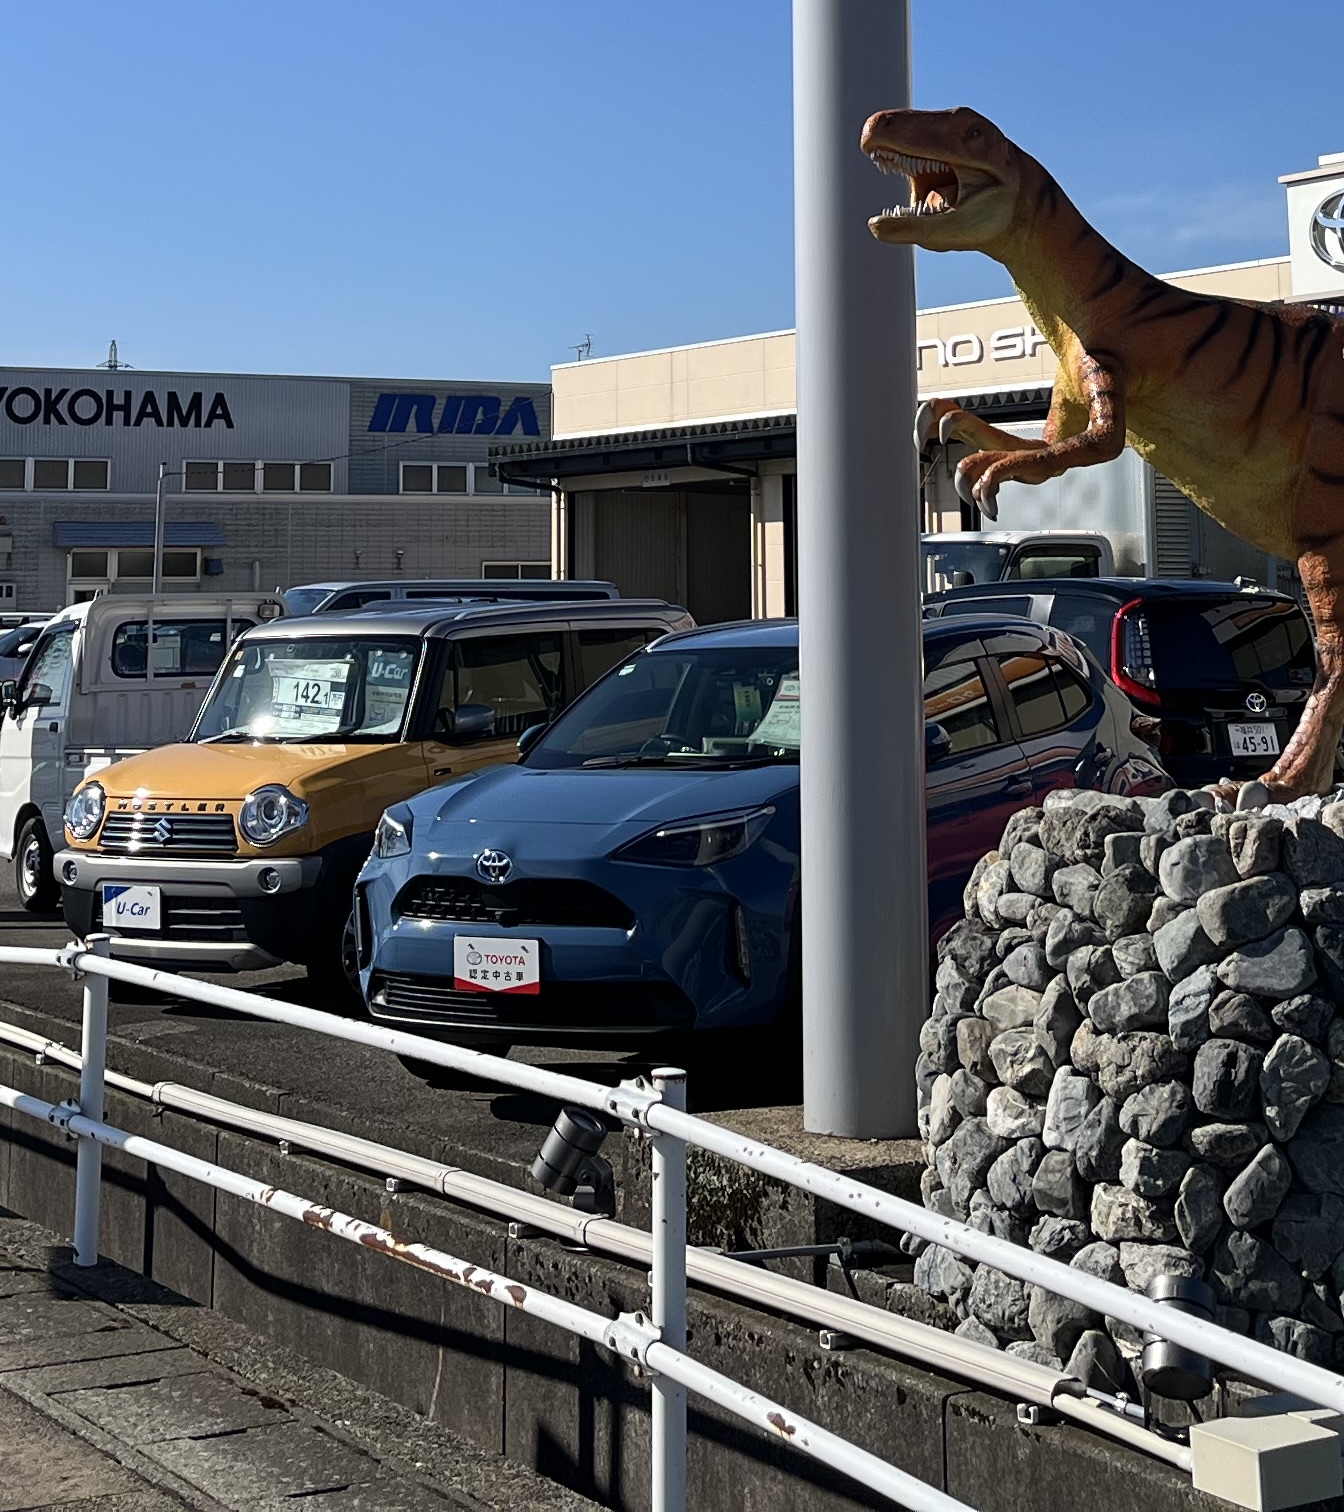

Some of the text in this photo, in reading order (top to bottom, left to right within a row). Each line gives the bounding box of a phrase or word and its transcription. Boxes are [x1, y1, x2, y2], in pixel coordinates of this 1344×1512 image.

[116, 895, 150, 915] U-Car
[484, 954, 525, 965] TOYOTA
[469, 968, 524, 981] 認定中古車
